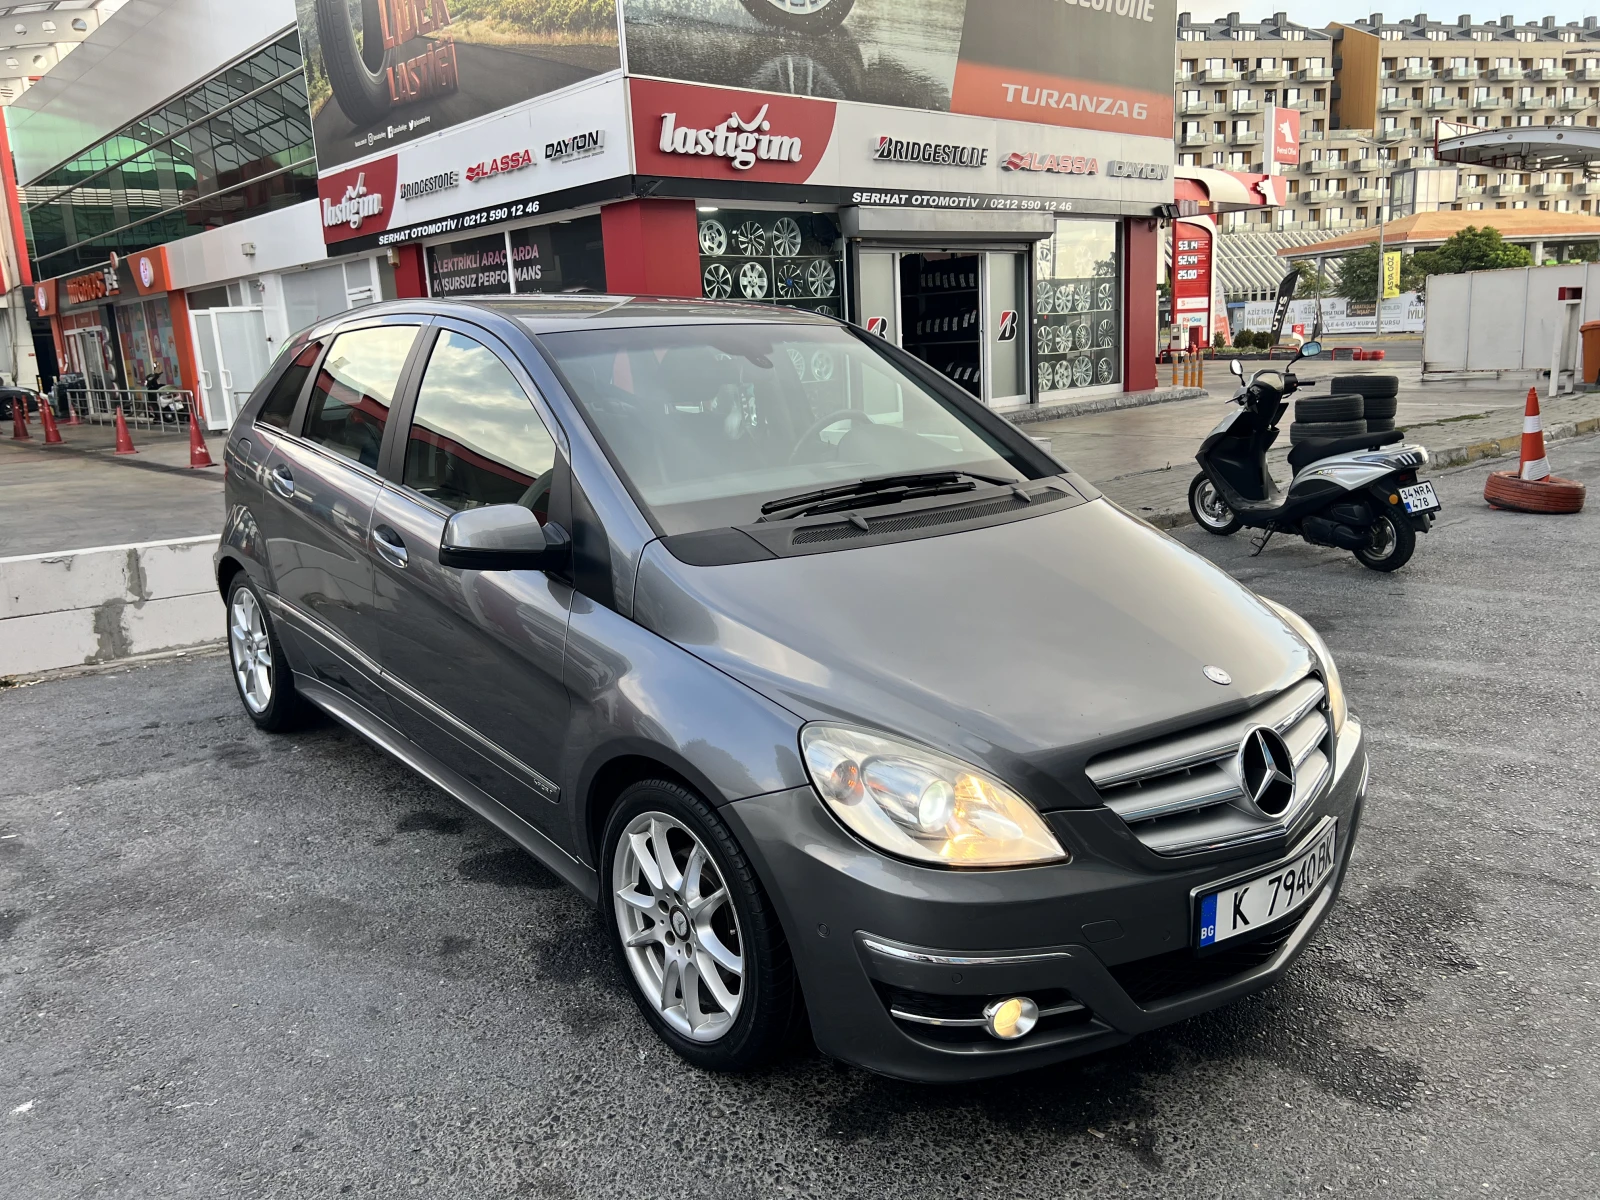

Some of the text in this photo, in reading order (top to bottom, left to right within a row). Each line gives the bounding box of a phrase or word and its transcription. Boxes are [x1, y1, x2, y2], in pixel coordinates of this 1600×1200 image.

[1001, 83, 1129, 118] TURANZA
[545, 130, 600, 160] DAYTON
[875, 136, 989, 167] BRIDGESTONE
[480, 148, 534, 178] LASSA
[1031, 153, 1099, 175] LASSA
[1115, 161, 1169, 180] DAYTON
[400, 171, 457, 200] BRIDGESTONE
[852, 192, 908, 205] SERHAT
[912, 195, 979, 208] OTOMOTİV
[990, 199, 1018, 209] 0212
[1021, 200, 1041, 210] 590
[1044, 201, 1057, 210] 12
[1059, 202, 1072, 211] 46
[378, 230, 411, 246] SERHAT
[411, 219, 457, 239] OTOMOTİV
[463, 212, 487, 227] 0212
[489, 207, 508, 221] 590
[510, 204, 524, 217] 12
[525, 200, 540, 213] 46
[1412, 497, 1430, 509] 478
[1231, 886, 1251, 931] K
[1200, 925, 1215, 940] BG
